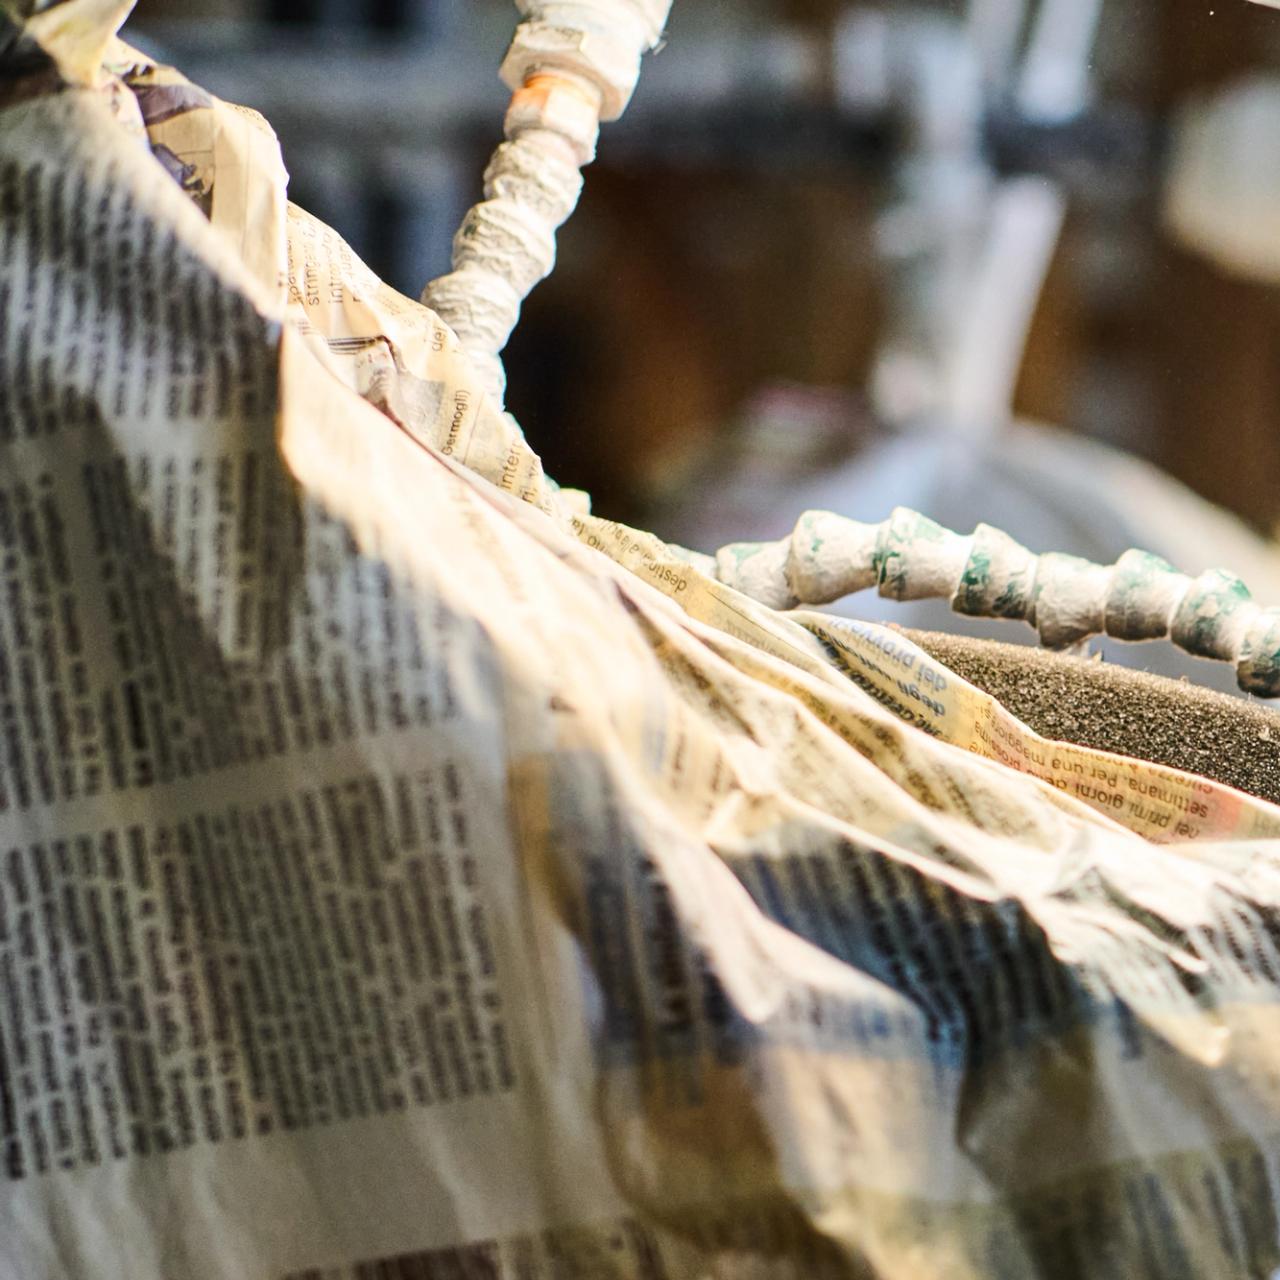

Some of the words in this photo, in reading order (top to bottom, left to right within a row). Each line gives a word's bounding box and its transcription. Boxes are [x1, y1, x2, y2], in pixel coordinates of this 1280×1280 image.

[1052, 757, 1086, 777] una
[1092, 766, 1118, 789] Per
[1075, 780, 1125, 809] giorni
[1129, 778, 1209, 819] settimana.
